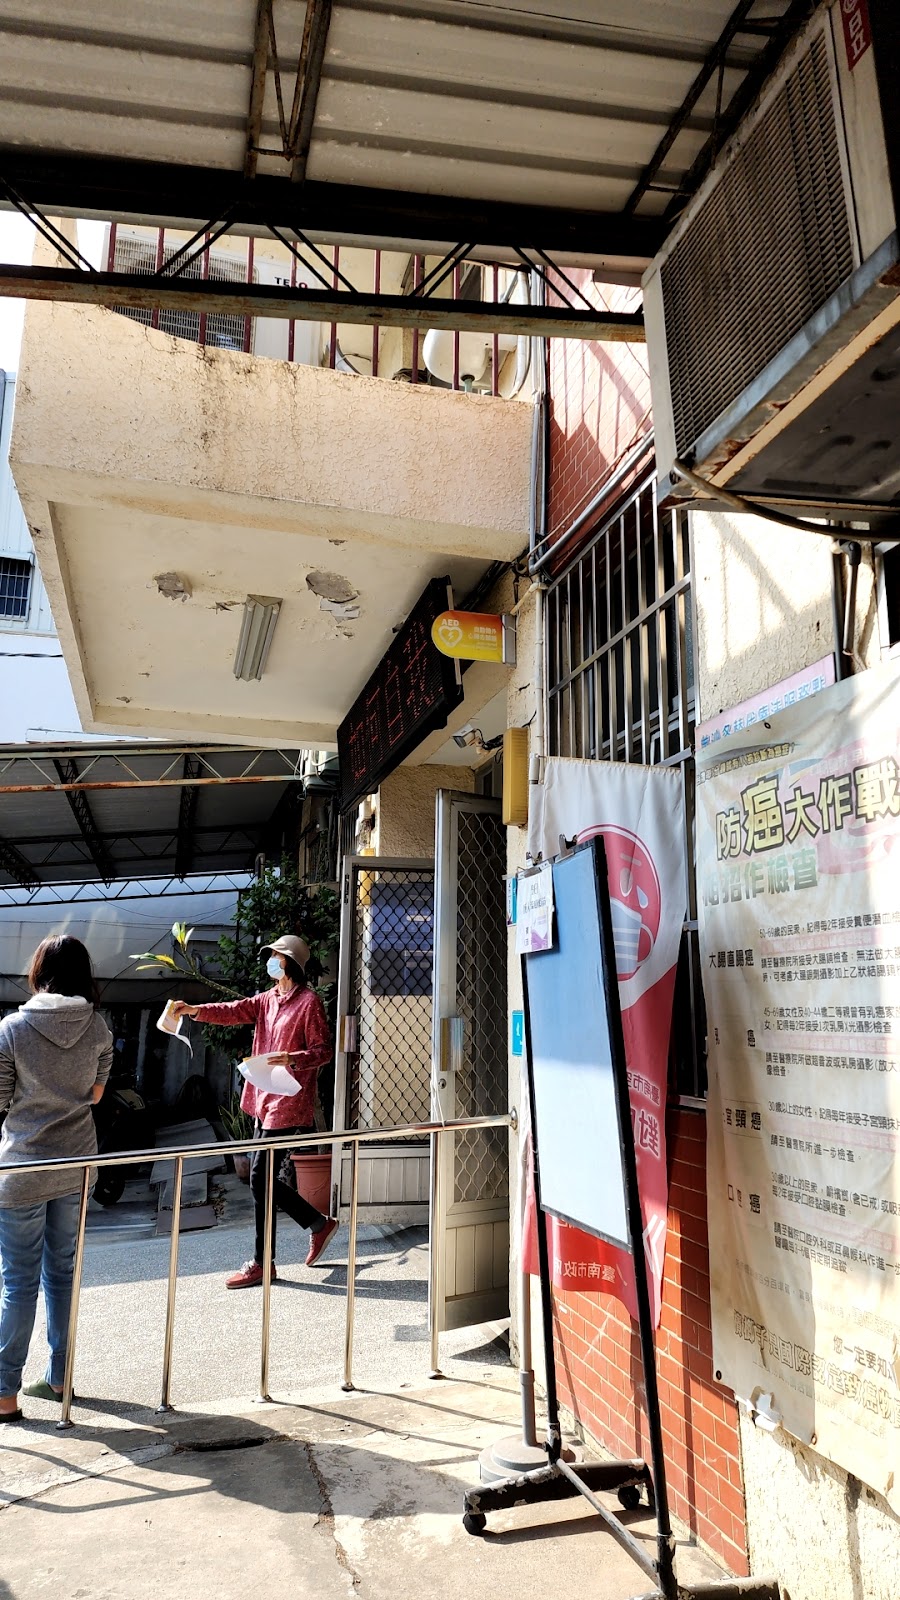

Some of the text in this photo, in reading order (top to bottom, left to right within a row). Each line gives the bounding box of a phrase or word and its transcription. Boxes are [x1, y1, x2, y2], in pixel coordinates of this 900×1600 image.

[274, 276, 308, 289] TEO
[441, 618, 460, 627] AED
[715, 756, 900, 861] 防癌大作戰
[709, 949, 754, 968] 大腸直腸癌
[723, 1108, 762, 1131] 宮頸癌
